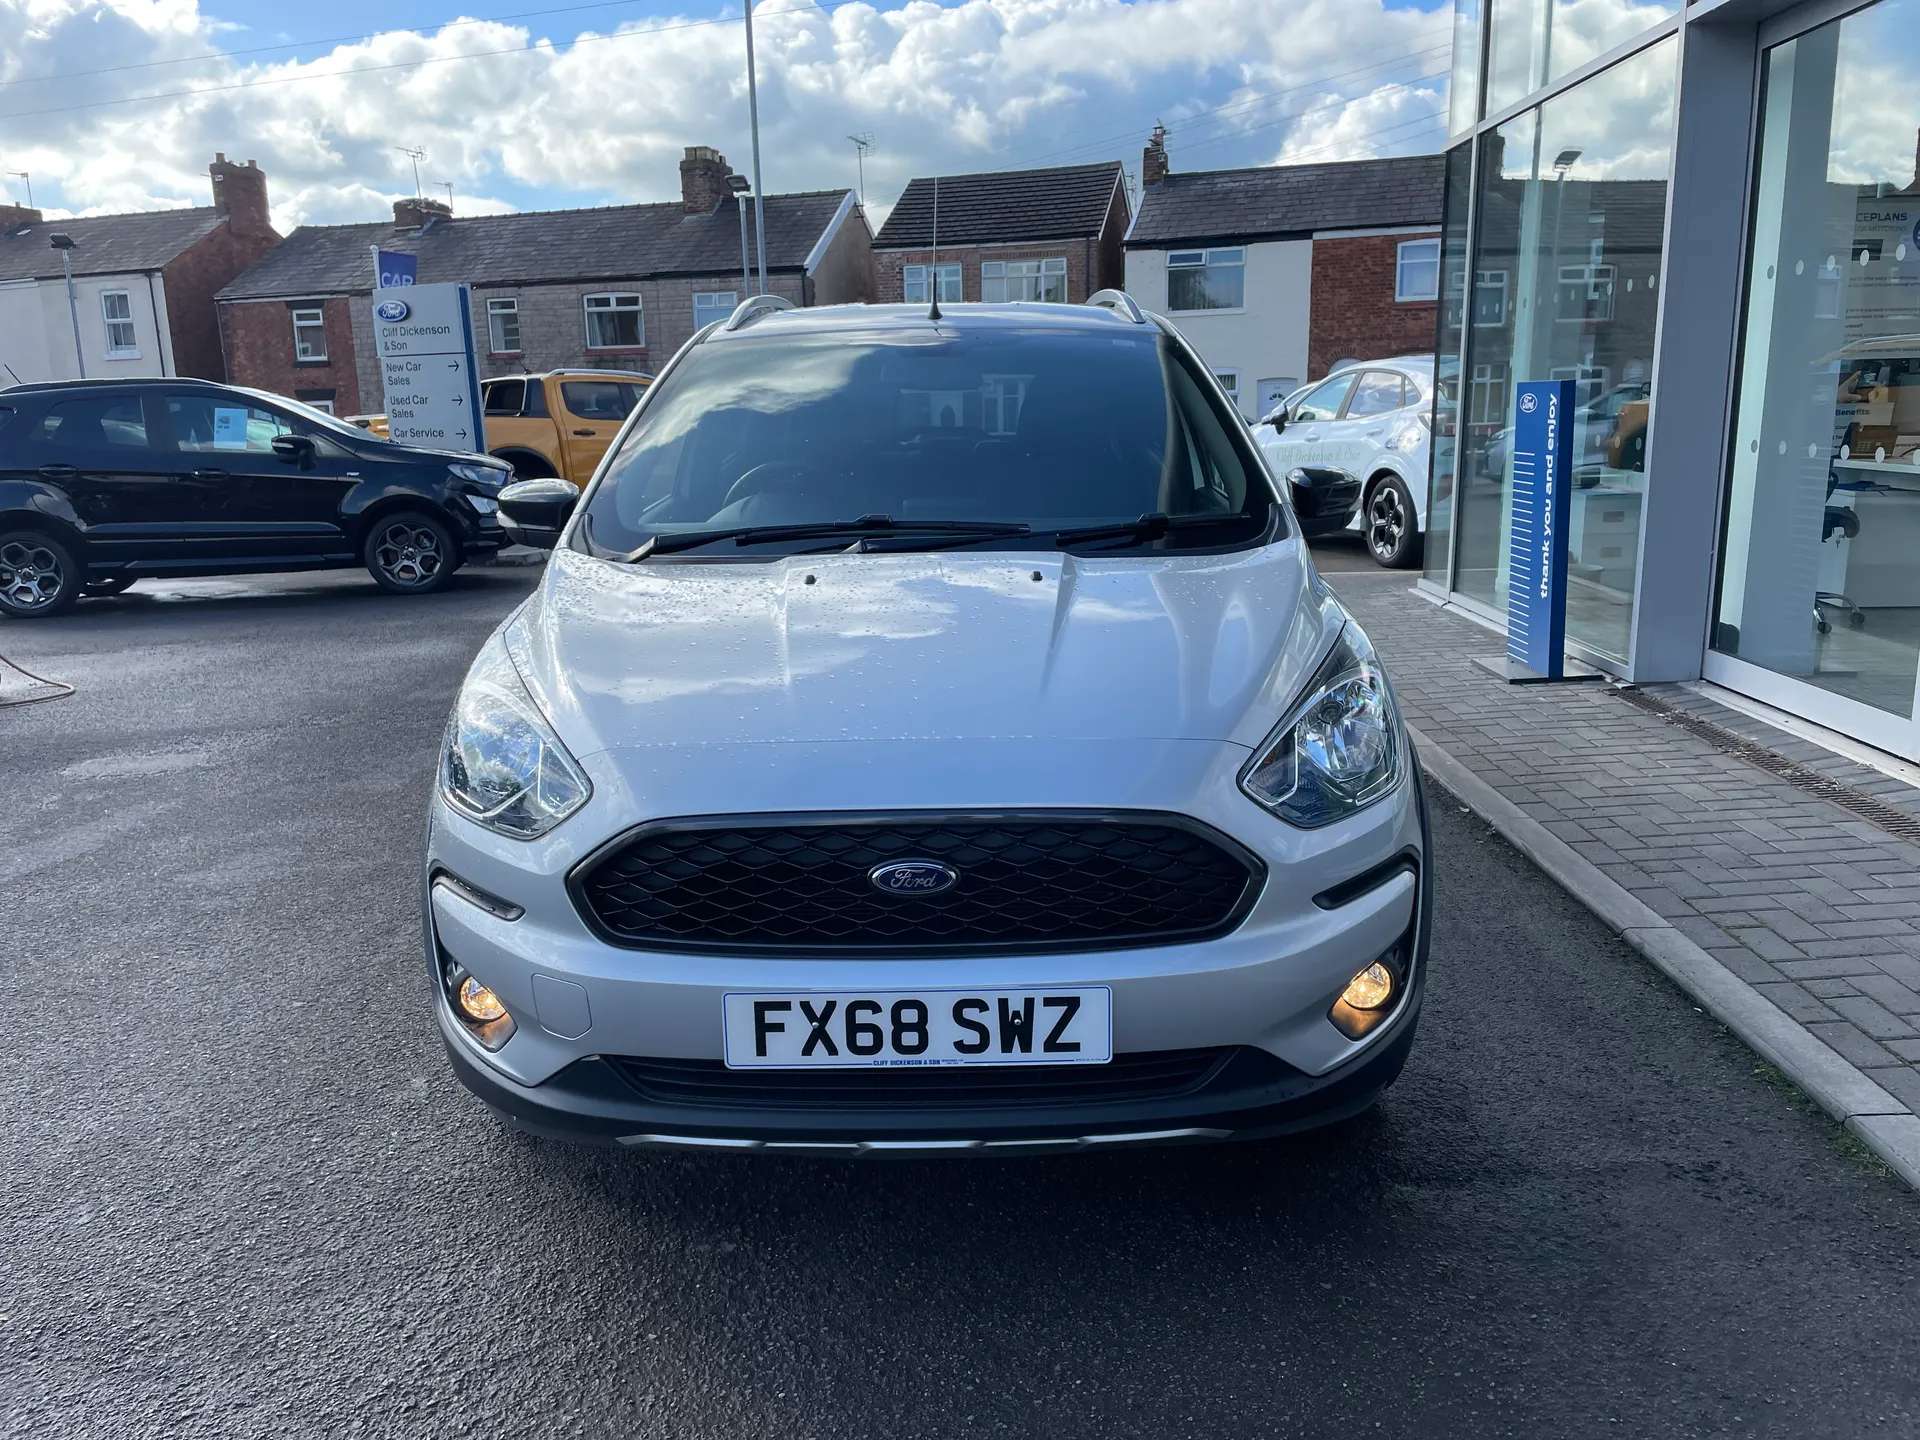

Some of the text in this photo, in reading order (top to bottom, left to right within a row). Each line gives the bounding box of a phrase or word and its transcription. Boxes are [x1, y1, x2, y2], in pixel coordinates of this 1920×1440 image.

[382, 324, 451, 338] Cliff Dickenson
[384, 340, 408, 352] & Son
[386, 361, 421, 373] New Car
[388, 375, 411, 386] Sales
[390, 394, 429, 405] Used Car
[392, 408, 415, 418] Sales
[394, 427, 445, 438] Car Service
[1540, 393, 1558, 599] thank you and enjoy
[890, 868, 938, 889] Ford
[753, 996, 1081, 1057] FX68 SWZ
